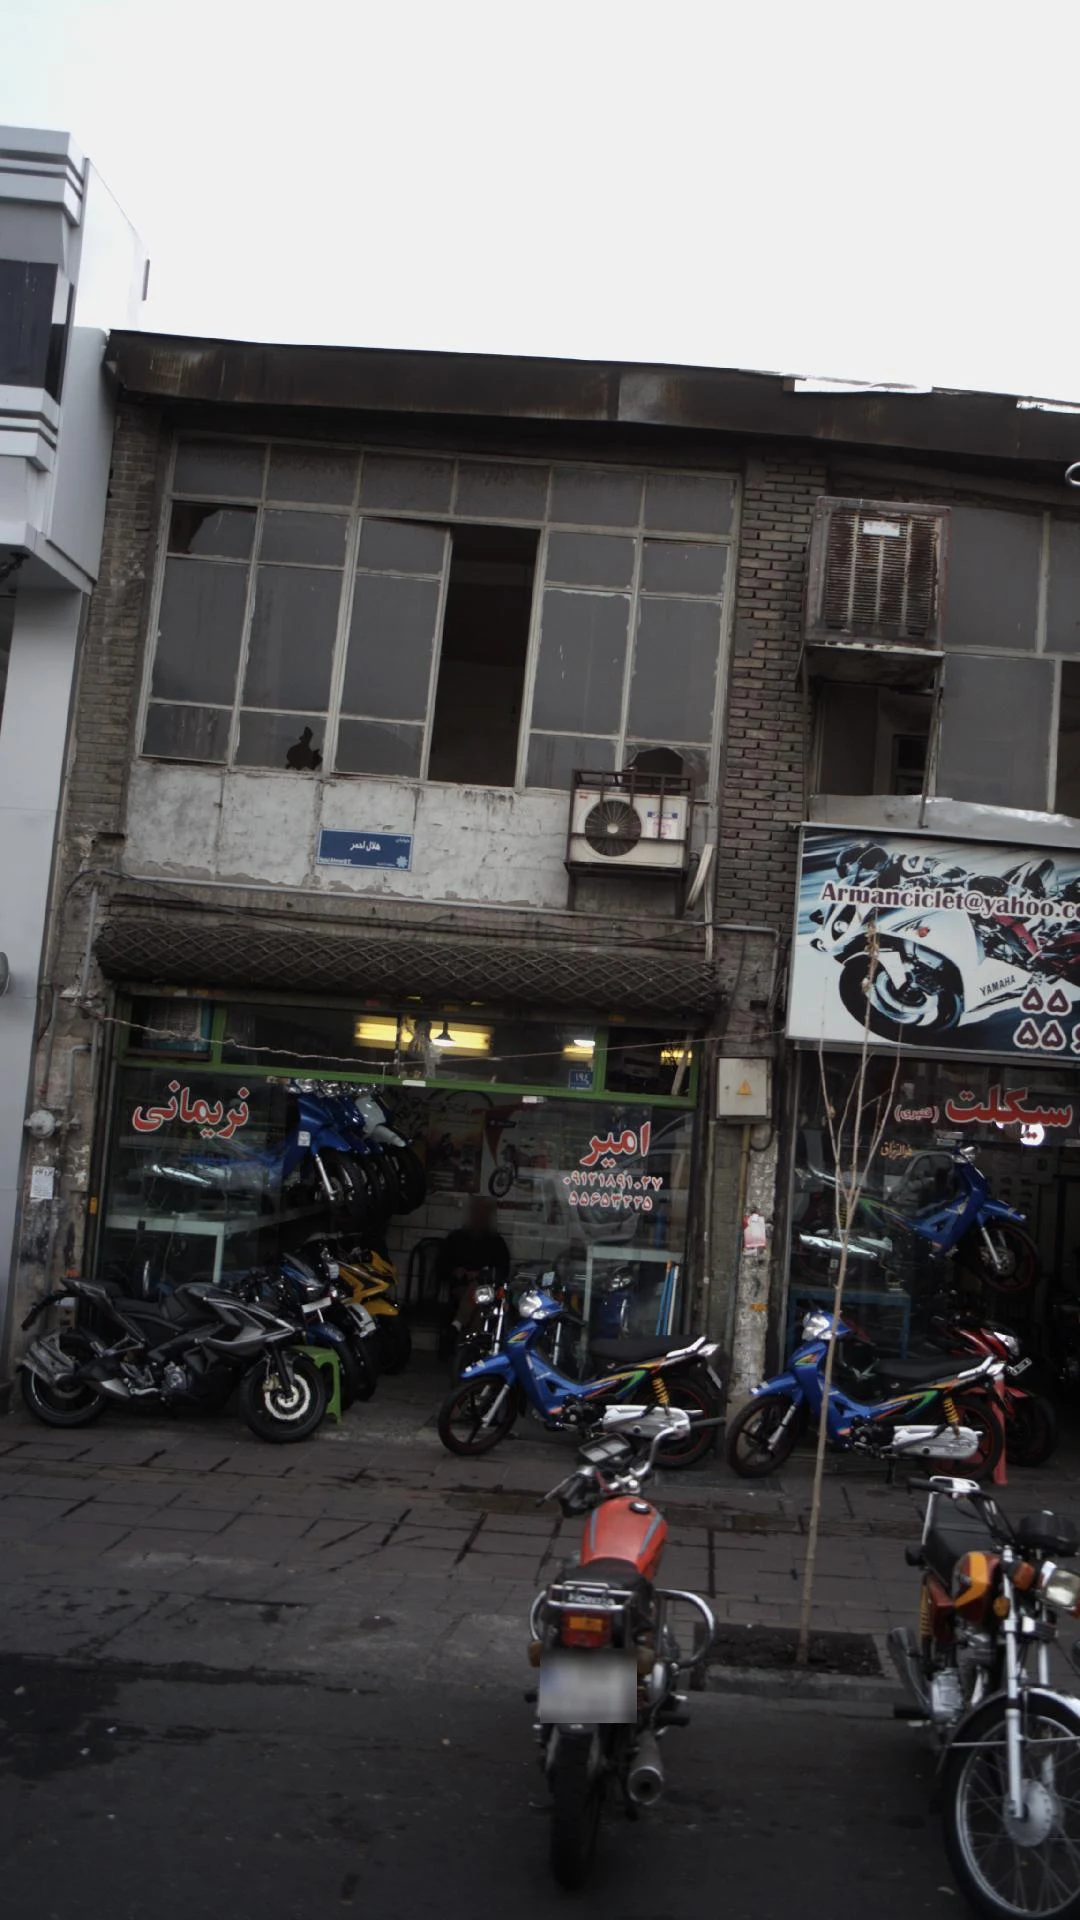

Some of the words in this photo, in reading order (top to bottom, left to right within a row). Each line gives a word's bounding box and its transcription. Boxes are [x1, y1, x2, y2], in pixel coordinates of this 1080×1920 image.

[979, 975, 1016, 996] YAMAHA
[132, 1080, 250, 1139] نریمانی
[945, 1084, 1073, 1140] سیکلت
[579, 1121, 652, 1168] امیر
